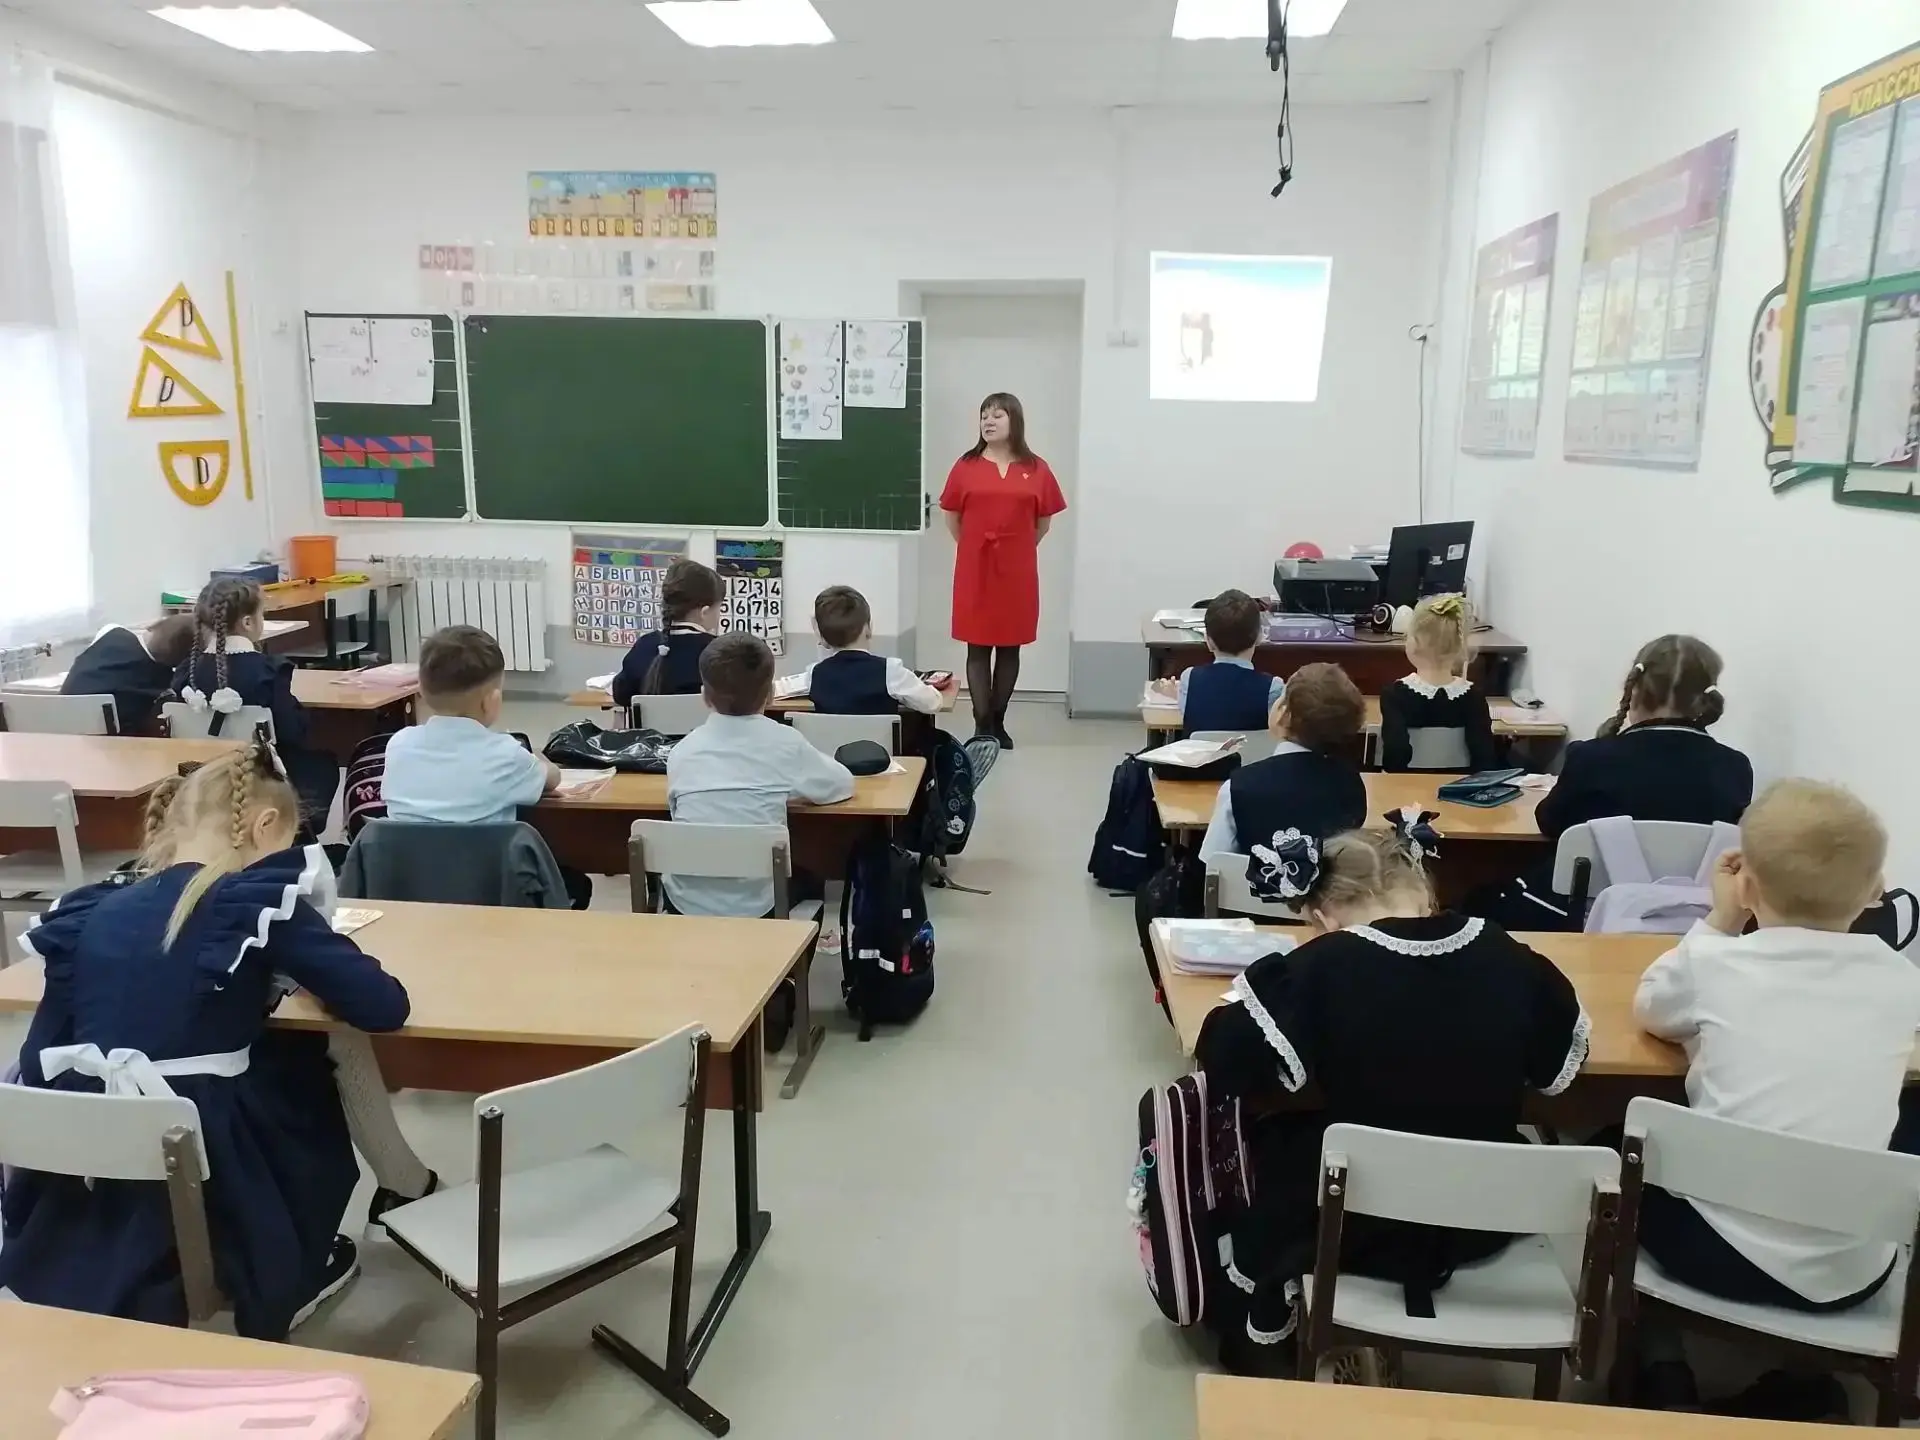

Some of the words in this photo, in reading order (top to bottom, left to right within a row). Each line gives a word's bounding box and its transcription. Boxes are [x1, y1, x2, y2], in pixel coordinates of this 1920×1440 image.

[886, 328, 904, 358] 2
[820, 366, 838, 393] 3
[819, 403, 840, 431] 5
[576, 567, 584, 578] А
[594, 568, 602, 578] Б
[611, 569, 620, 580] В
[625, 568, 632, 580] Г
[642, 572, 651, 582] Д
[579, 582, 588, 593] Ж
[640, 586, 650, 595] К
[738, 579, 748, 594] 2
[754, 581, 763, 596] 3
[770, 581, 780, 596] 4
[576, 597, 588, 609] Н
[595, 600, 604, 610] О
[610, 601, 619, 611] П
[627, 601, 635, 611] Р
[735, 600, 746, 615] 6
[752, 601, 762, 615] 7
[769, 600, 779, 615] 8
[578, 614, 588, 625] Ф
[594, 615, 602, 627] Х
[610, 616, 619, 627] Ц
[625, 617, 634, 628] Ч
[720, 618, 730, 633] 9
[625, 633, 635, 643] Ю
